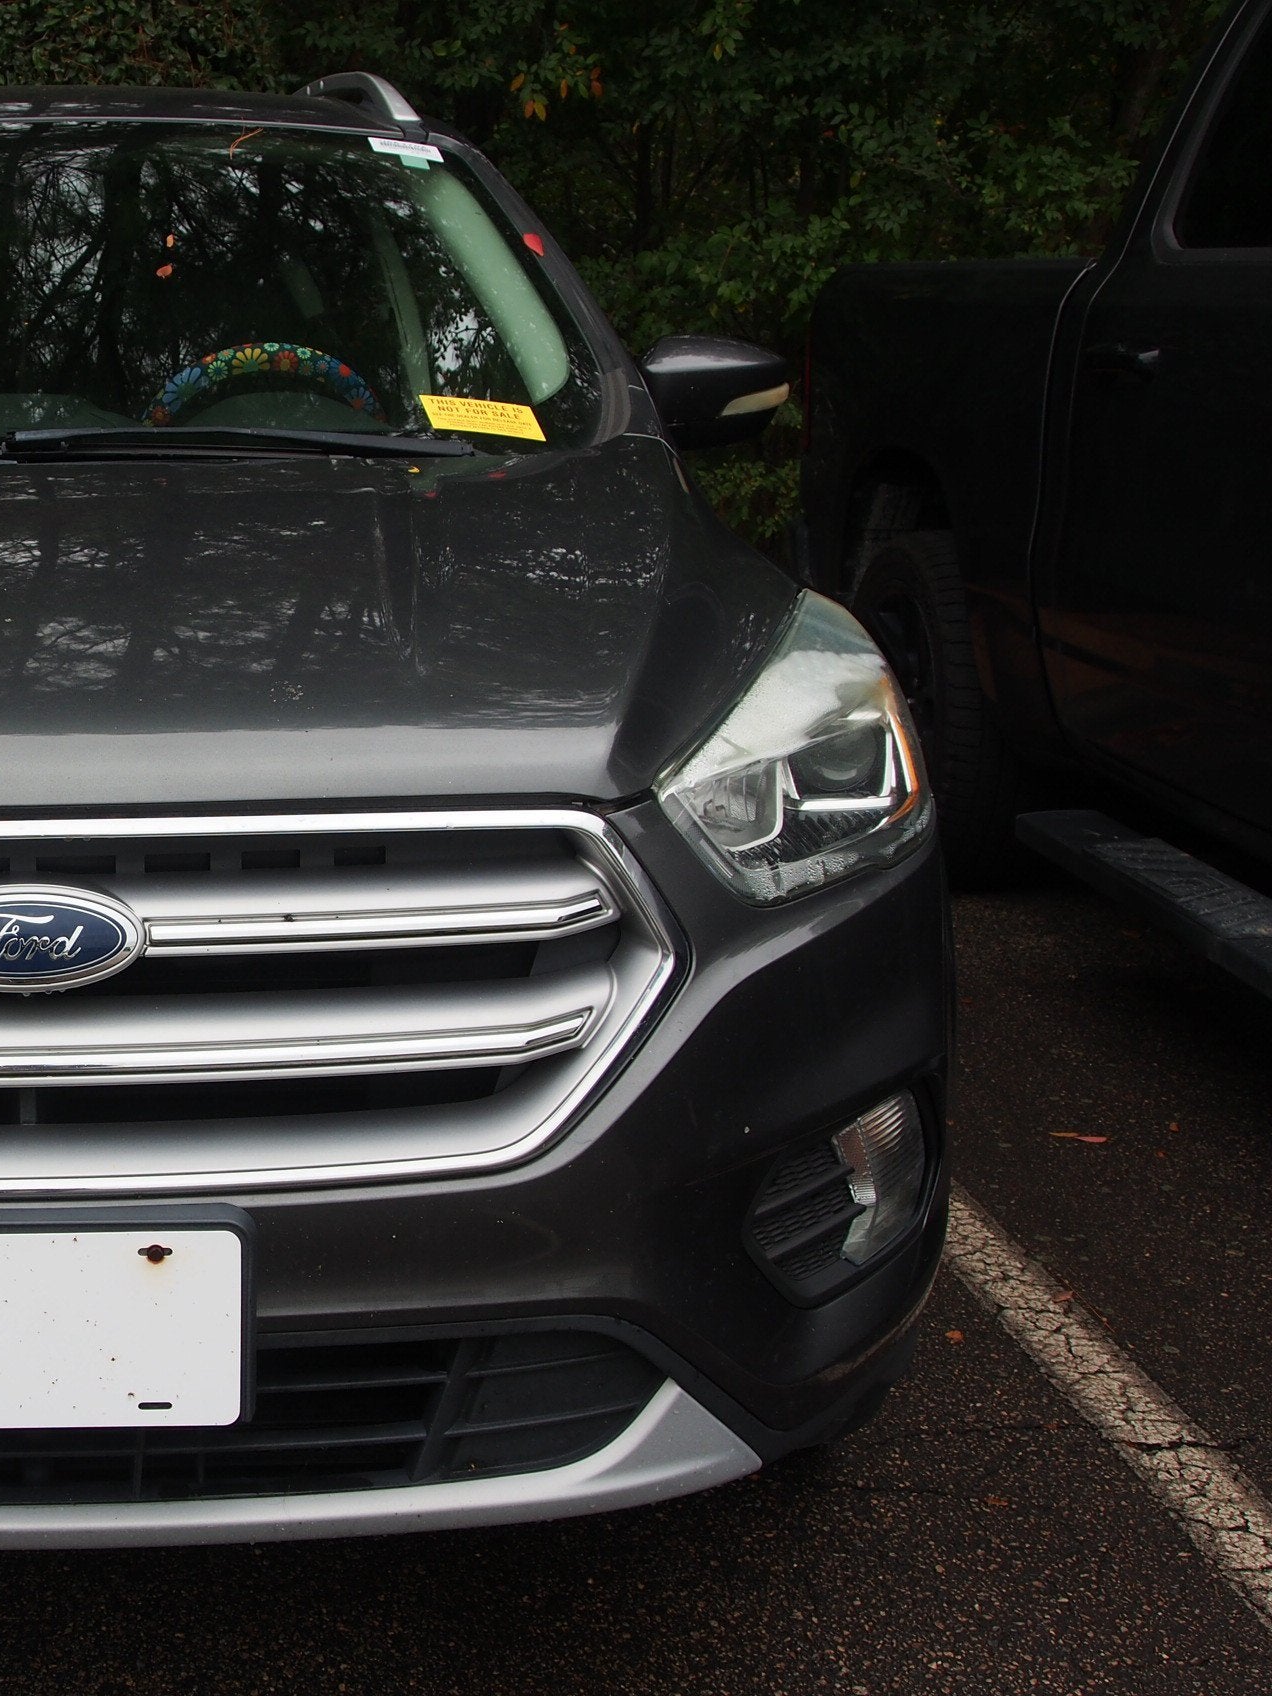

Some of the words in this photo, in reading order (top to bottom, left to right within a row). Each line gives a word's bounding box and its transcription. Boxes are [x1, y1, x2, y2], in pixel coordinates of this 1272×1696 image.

[430, 398, 457, 406] THIS
[459, 401, 508, 412] VEHICLE
[437, 405, 459, 413] NOT
[465, 408, 488, 416] FOR
[491, 410, 520, 420] SALE
